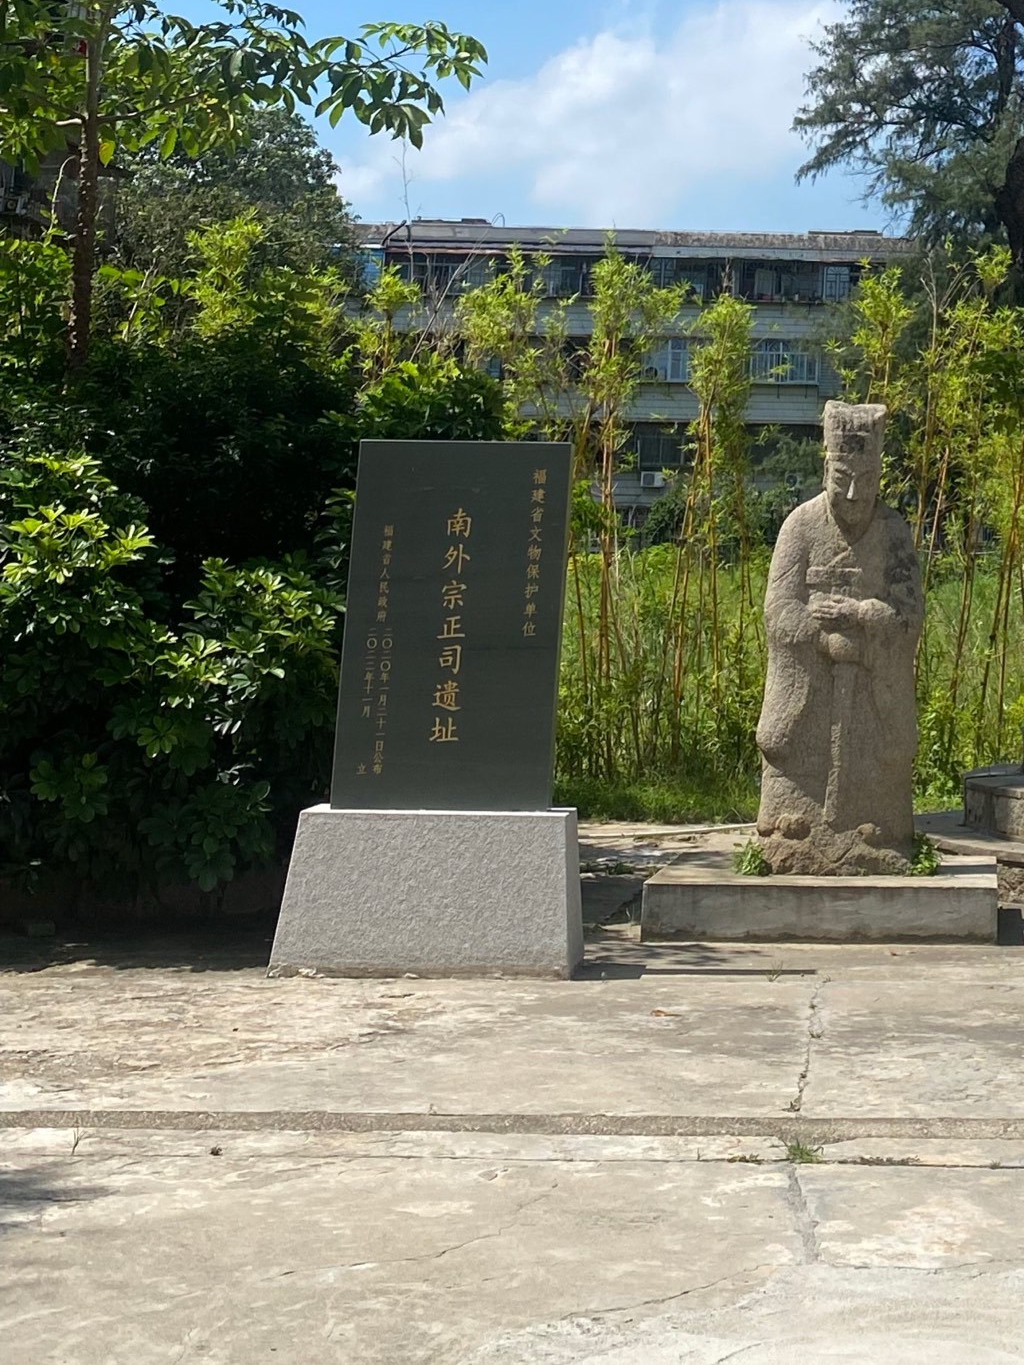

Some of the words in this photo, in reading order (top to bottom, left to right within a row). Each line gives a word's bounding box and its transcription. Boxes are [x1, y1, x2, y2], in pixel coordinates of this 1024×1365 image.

[375, 524, 394, 623] 福建省人民政府
[428, 507, 473, 743] 南外宗正司遗址
[521, 468, 548, 637] 福建省文物保护单位
